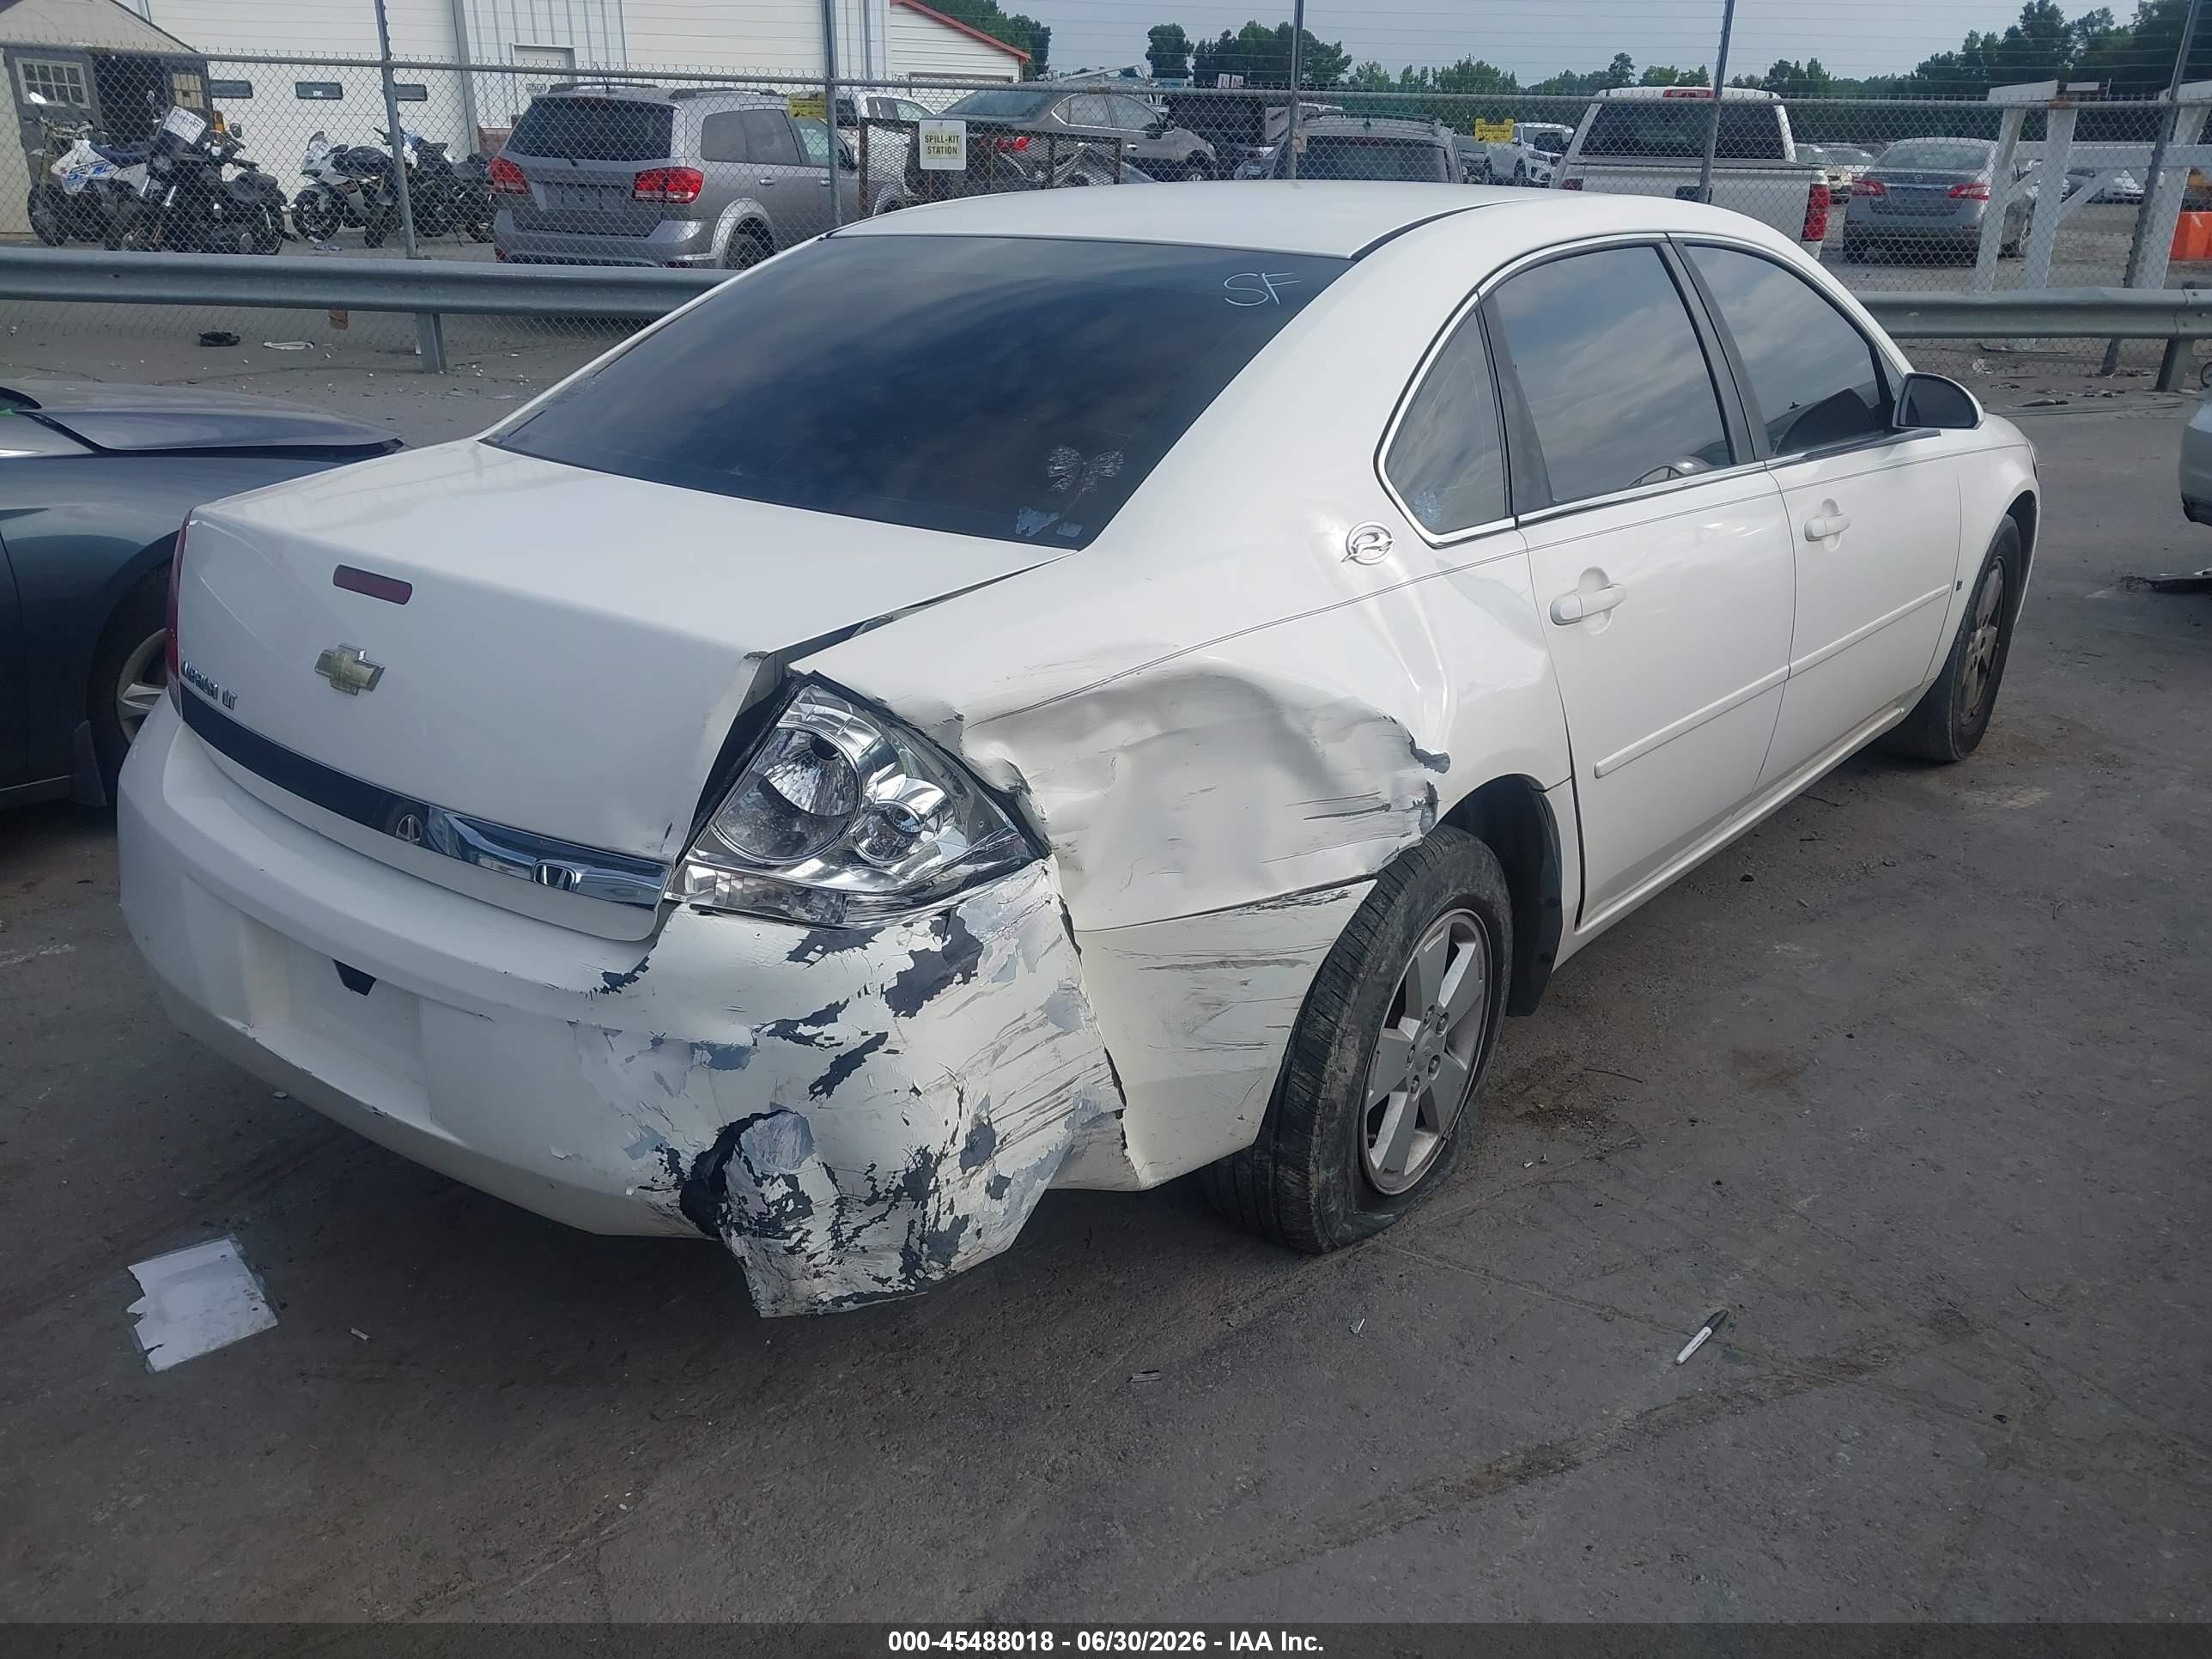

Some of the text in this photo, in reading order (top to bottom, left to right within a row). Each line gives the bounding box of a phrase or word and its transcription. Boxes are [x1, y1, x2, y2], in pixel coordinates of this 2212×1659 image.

[924, 135, 960, 143] SPILL-KIT
[927, 146, 957, 155] STATION
[1224, 272, 1302, 307] SF
